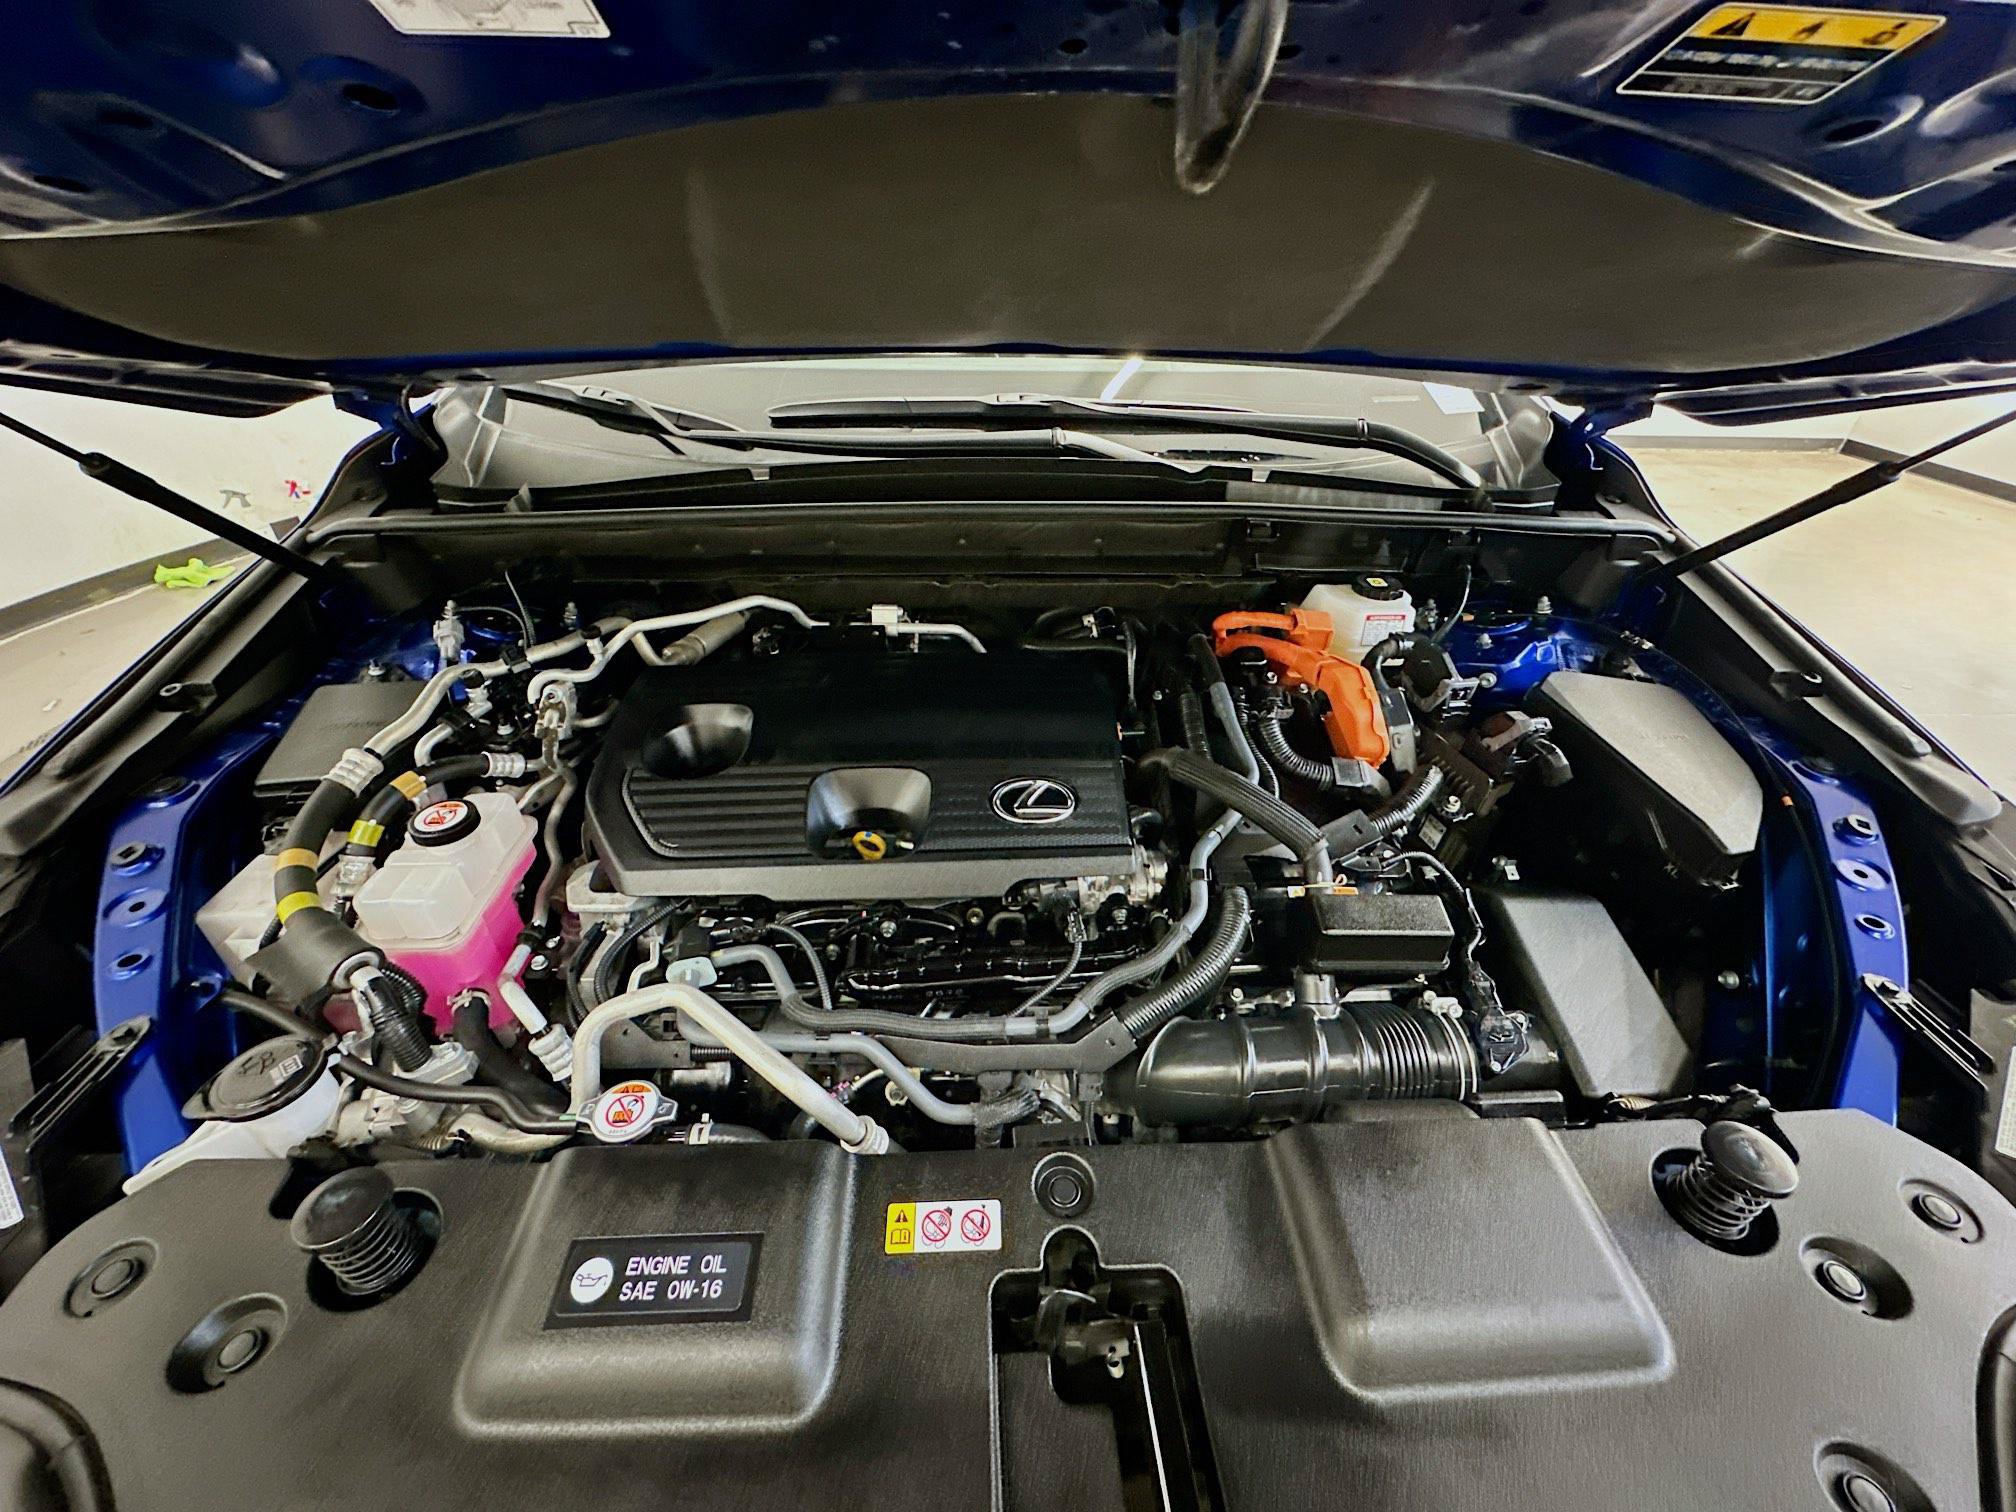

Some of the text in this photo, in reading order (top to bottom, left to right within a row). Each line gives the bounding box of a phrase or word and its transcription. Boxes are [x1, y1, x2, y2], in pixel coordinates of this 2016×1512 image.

[625, 1254, 727, 1276] ENGINE OIL
[619, 1279, 723, 1301] SAE 0W-16
